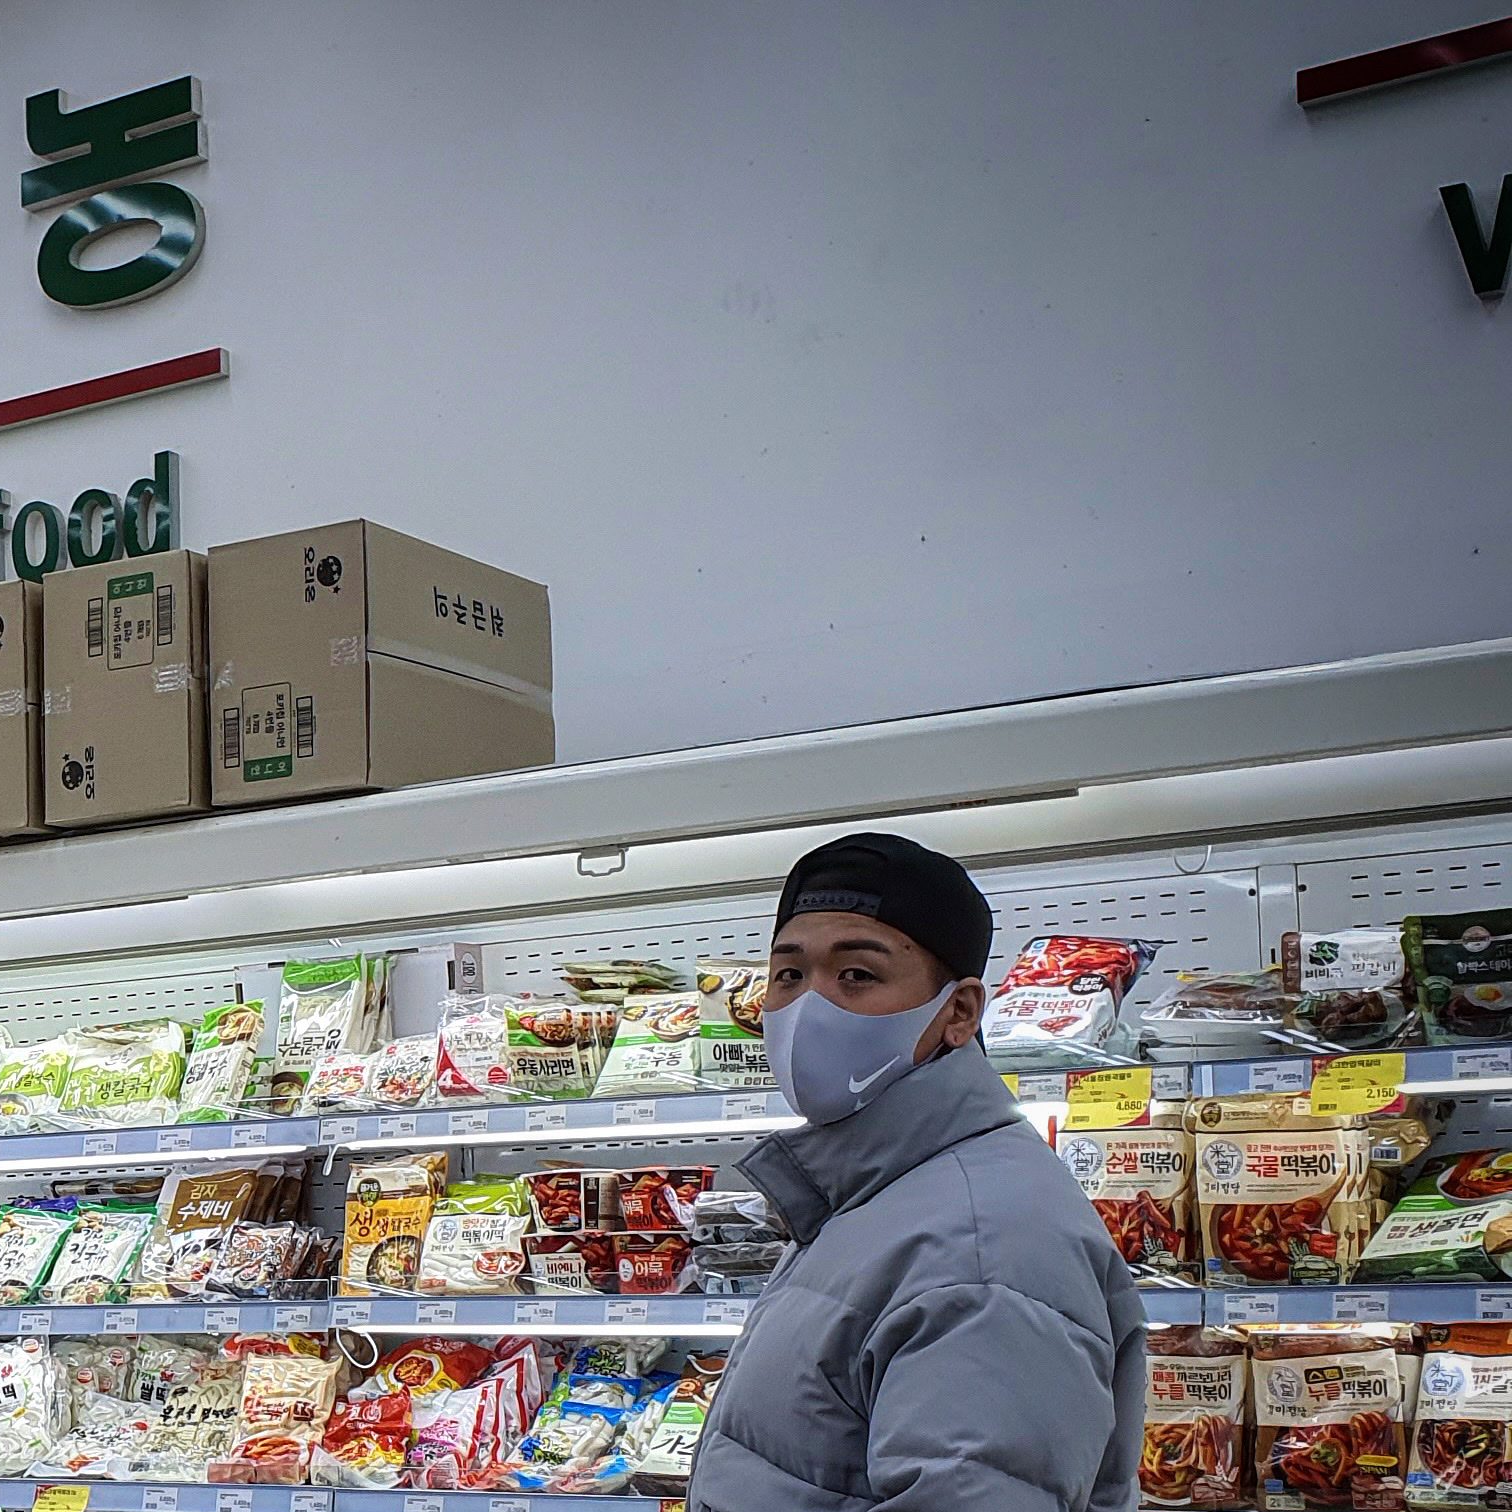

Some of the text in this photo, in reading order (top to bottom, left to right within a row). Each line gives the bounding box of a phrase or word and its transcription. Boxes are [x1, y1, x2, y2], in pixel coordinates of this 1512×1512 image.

[304, 546, 316, 603] 오리온
[112, 579, 148, 594] 어니언
[433, 586, 504, 637] 취급주의
[276, 693, 285, 749] 포카칩 어니언
[84, 745, 95, 800] 오리온
[250, 761, 286, 776] 어니언
[516, 1058, 576, 1078] 우동사리면
[650, 1051, 682, 1068] 우동
[97, 1077, 155, 1100] 생칼국수
[1105, 1151, 1187, 1175] 순쌀 떡볶이
[1246, 1153, 1336, 1178] 국물 떡볶이
[188, 1183, 216, 1201] 감자
[177, 1200, 230, 1221] 수제비
[546, 1261, 582, 1275] 비엔나
[635, 1260, 664, 1277] 어묵
[1151, 1369, 1176, 1384] 매콤
[1151, 1383, 1232, 1401] 누들 떡볶이
[1308, 1378, 1389, 1401] 누들 떡볶이
